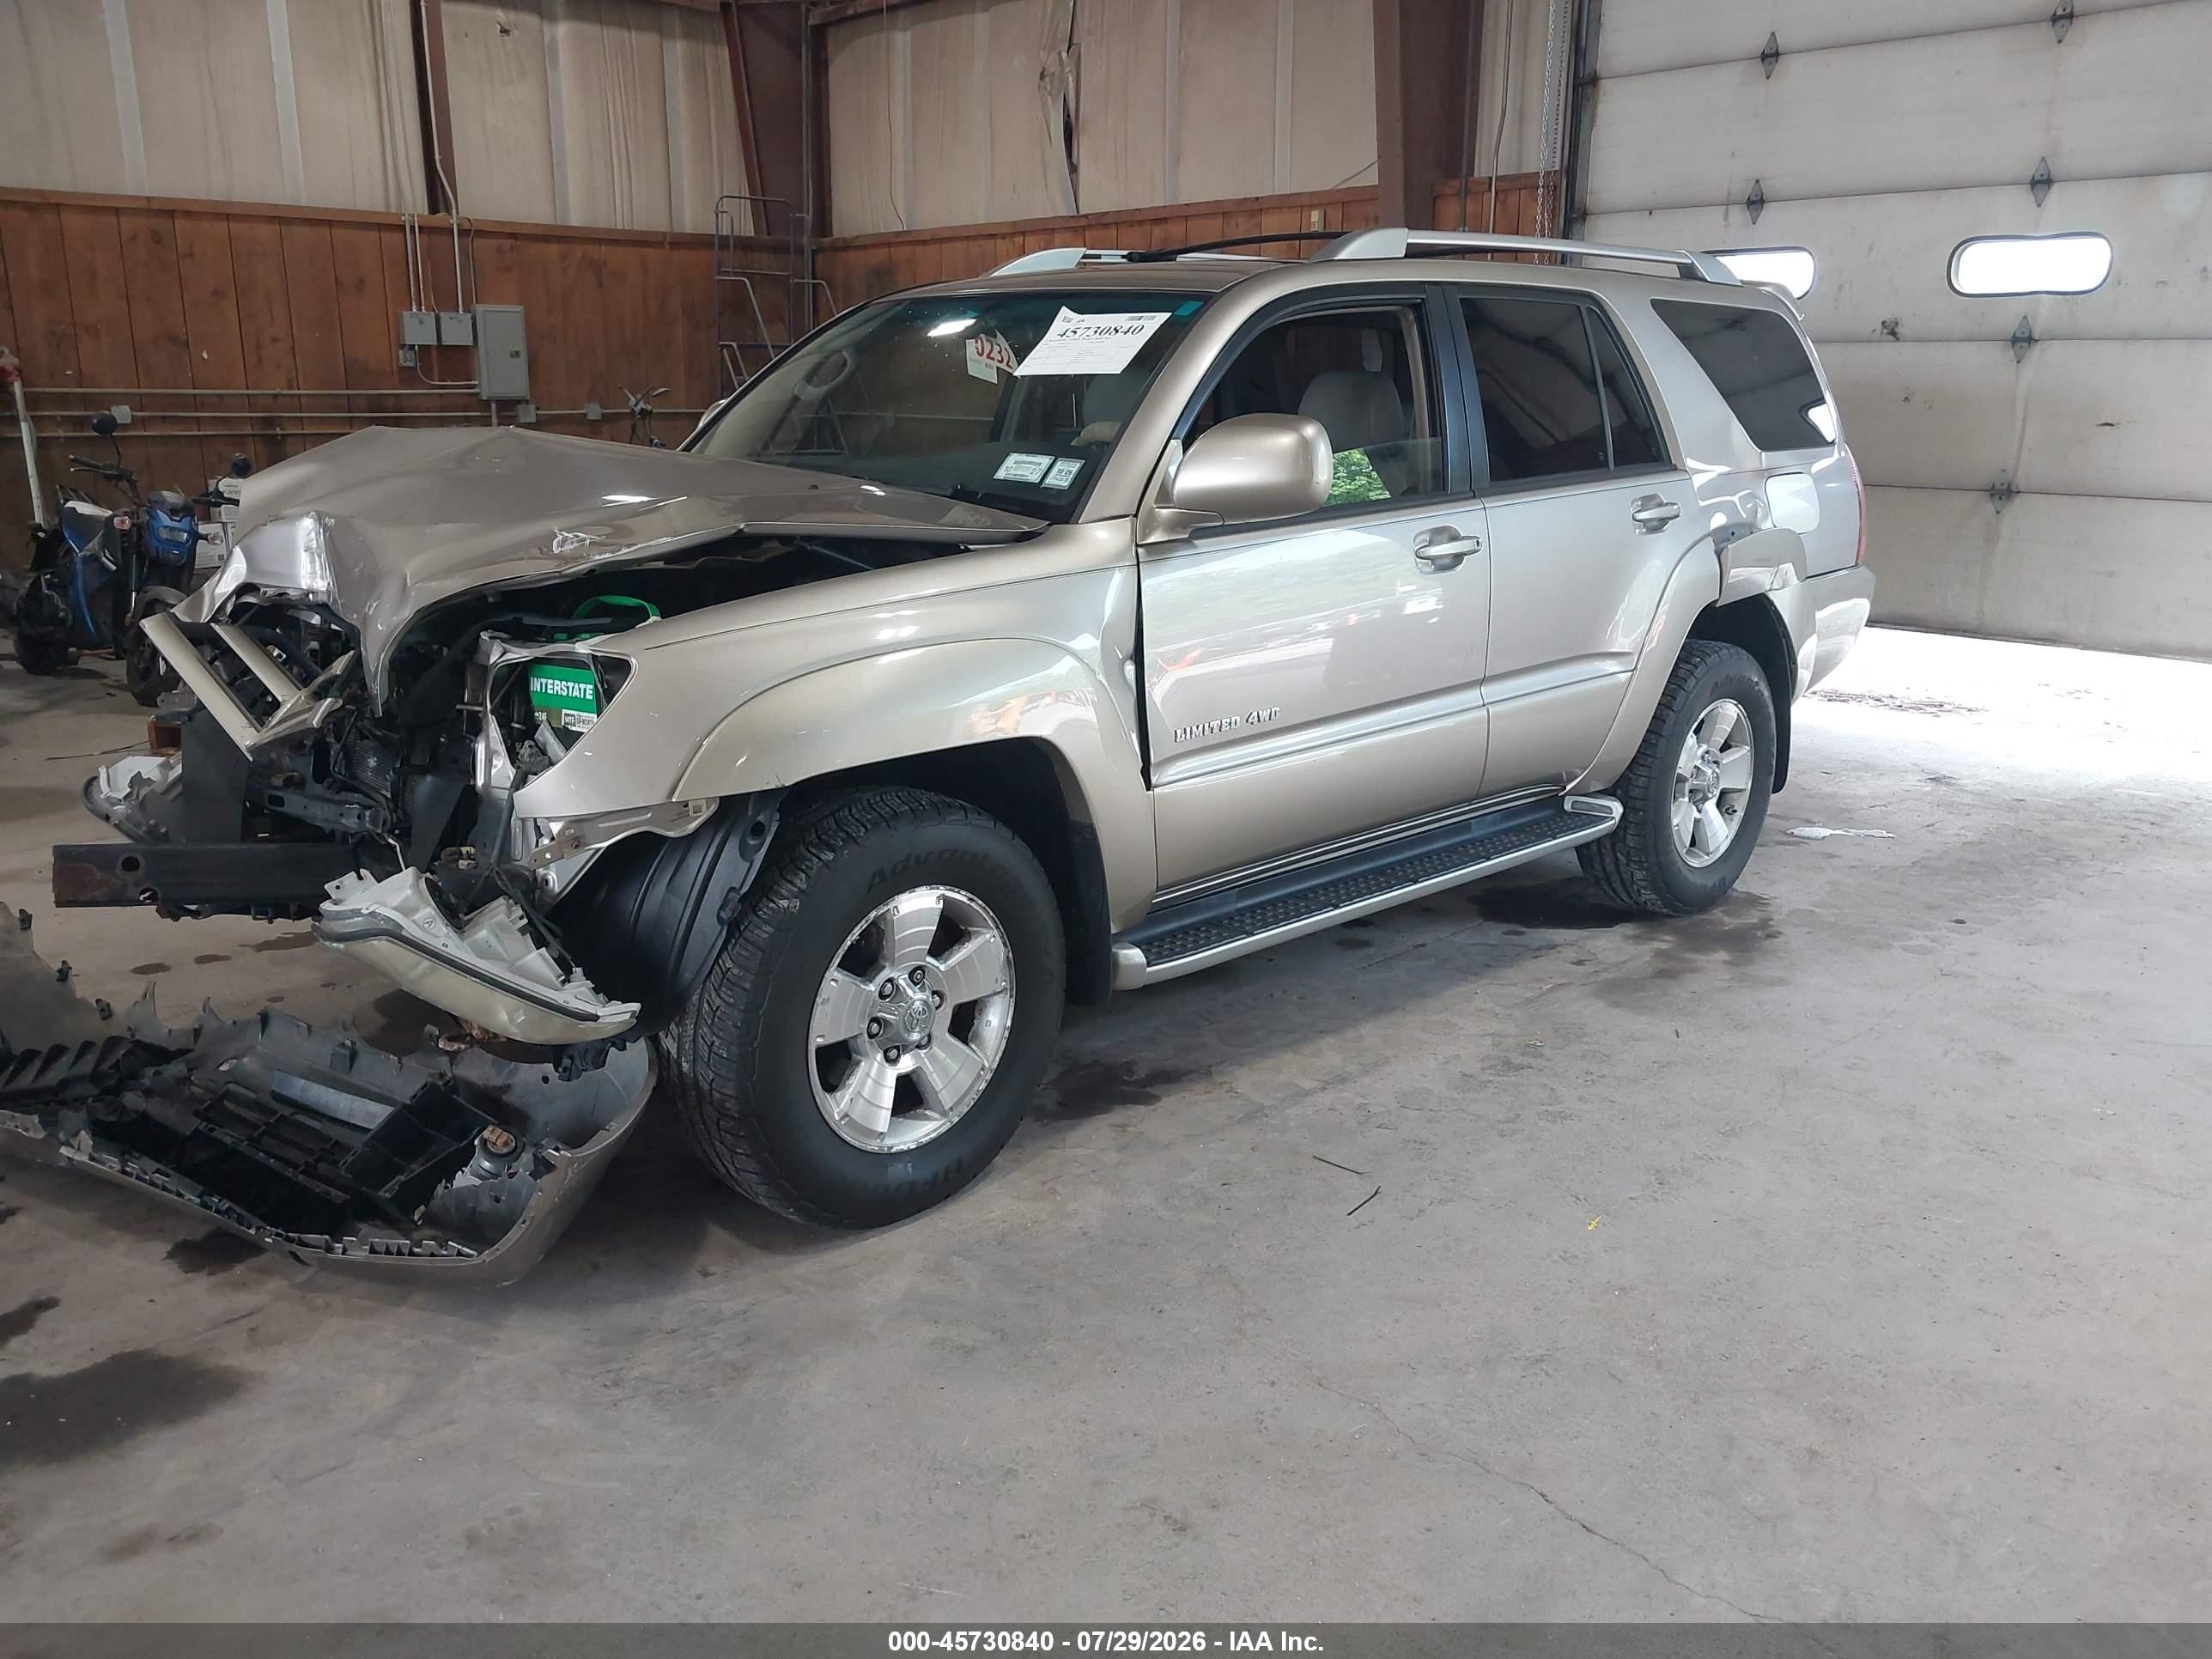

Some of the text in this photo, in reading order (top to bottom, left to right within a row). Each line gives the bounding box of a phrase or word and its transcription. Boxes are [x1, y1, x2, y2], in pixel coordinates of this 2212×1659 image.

[1057, 324, 1145, 338] 45730840
[530, 677, 593, 700] INTERSTATE
[1174, 707, 1280, 743] LIMITED 4WD
